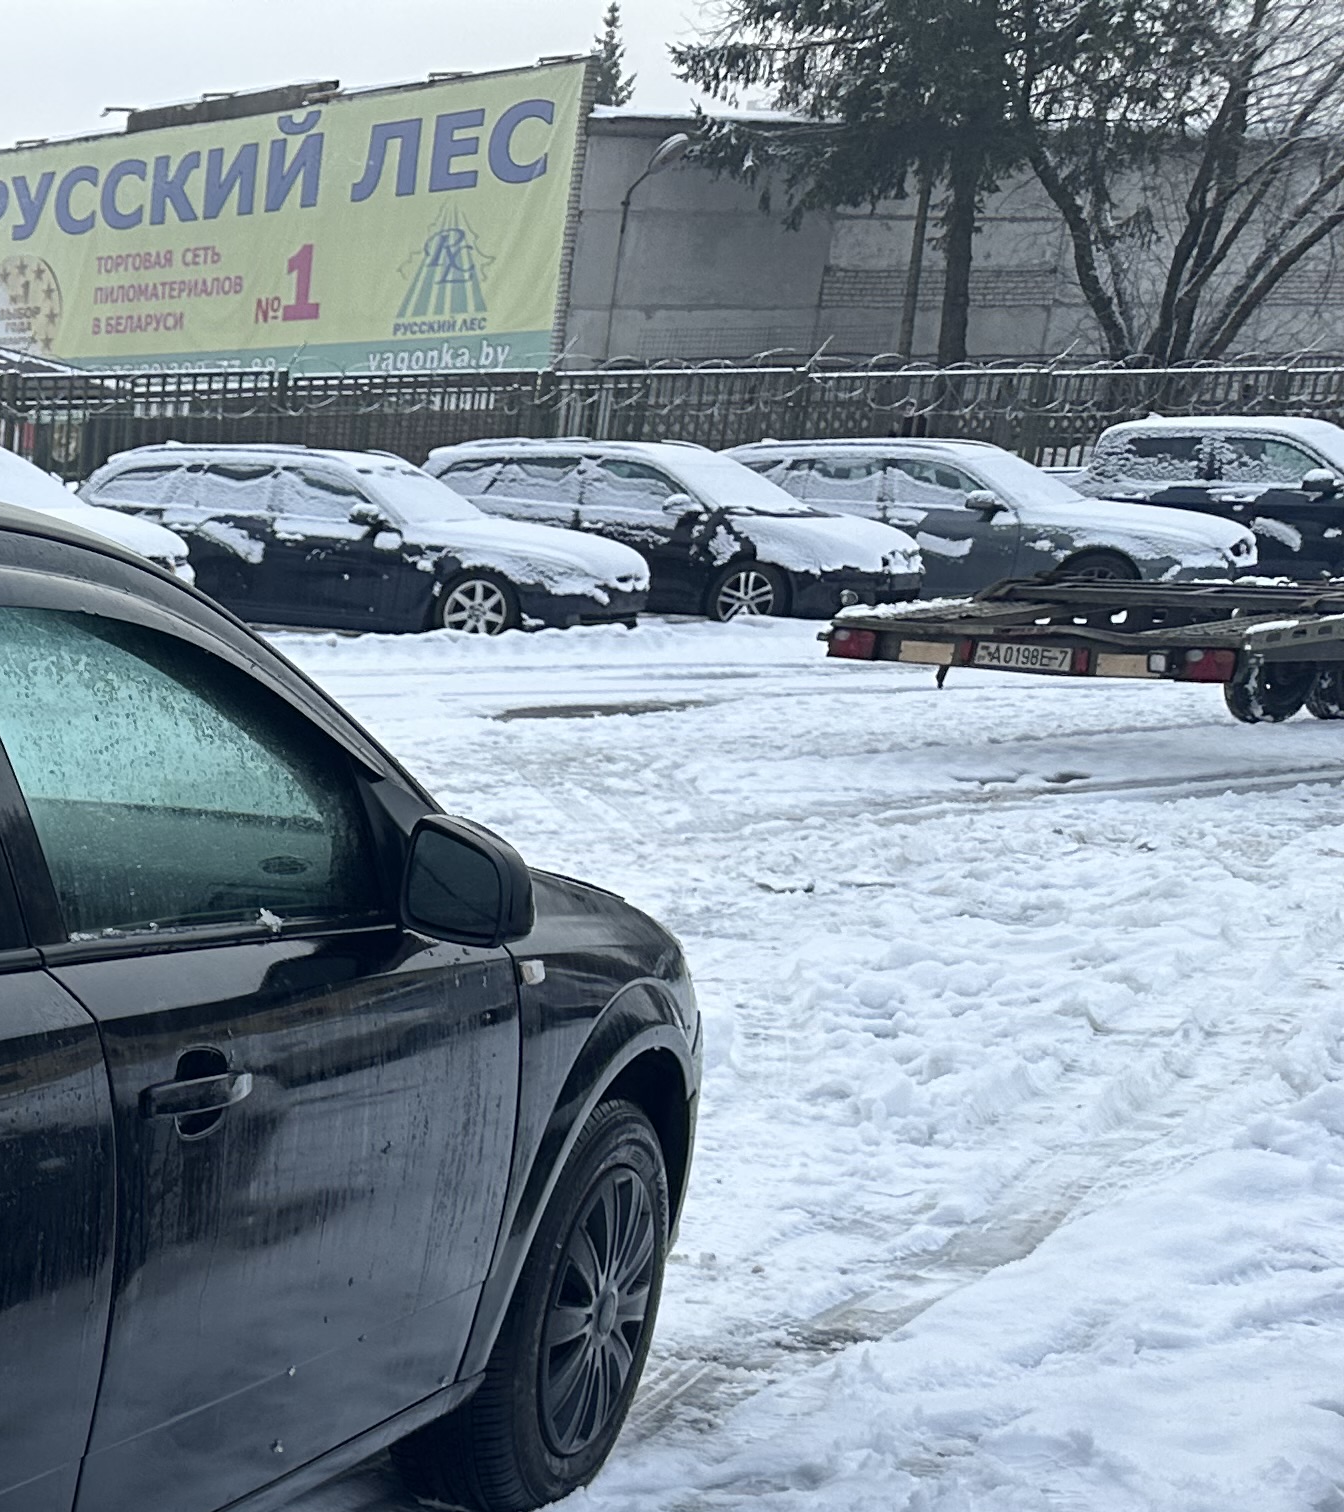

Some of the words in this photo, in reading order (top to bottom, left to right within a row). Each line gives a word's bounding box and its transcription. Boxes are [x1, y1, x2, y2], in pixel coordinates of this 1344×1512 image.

[350, 99, 555, 203] ЛЕС
[96, 250, 174, 275] ТОРГОВАЯ
[182, 245, 222, 268] СЕТЬ
[93, 275, 244, 306] ПИЛОМАТЕРИАЛОВ
[91, 316, 102, 336] В
[104, 312, 185, 335] БЕЛАРУСИ
[392, 316, 455, 336] РУССКИЙ
[458, 317, 488, 332] ЛЕС
[368, 340, 511, 371] vagonka.by
